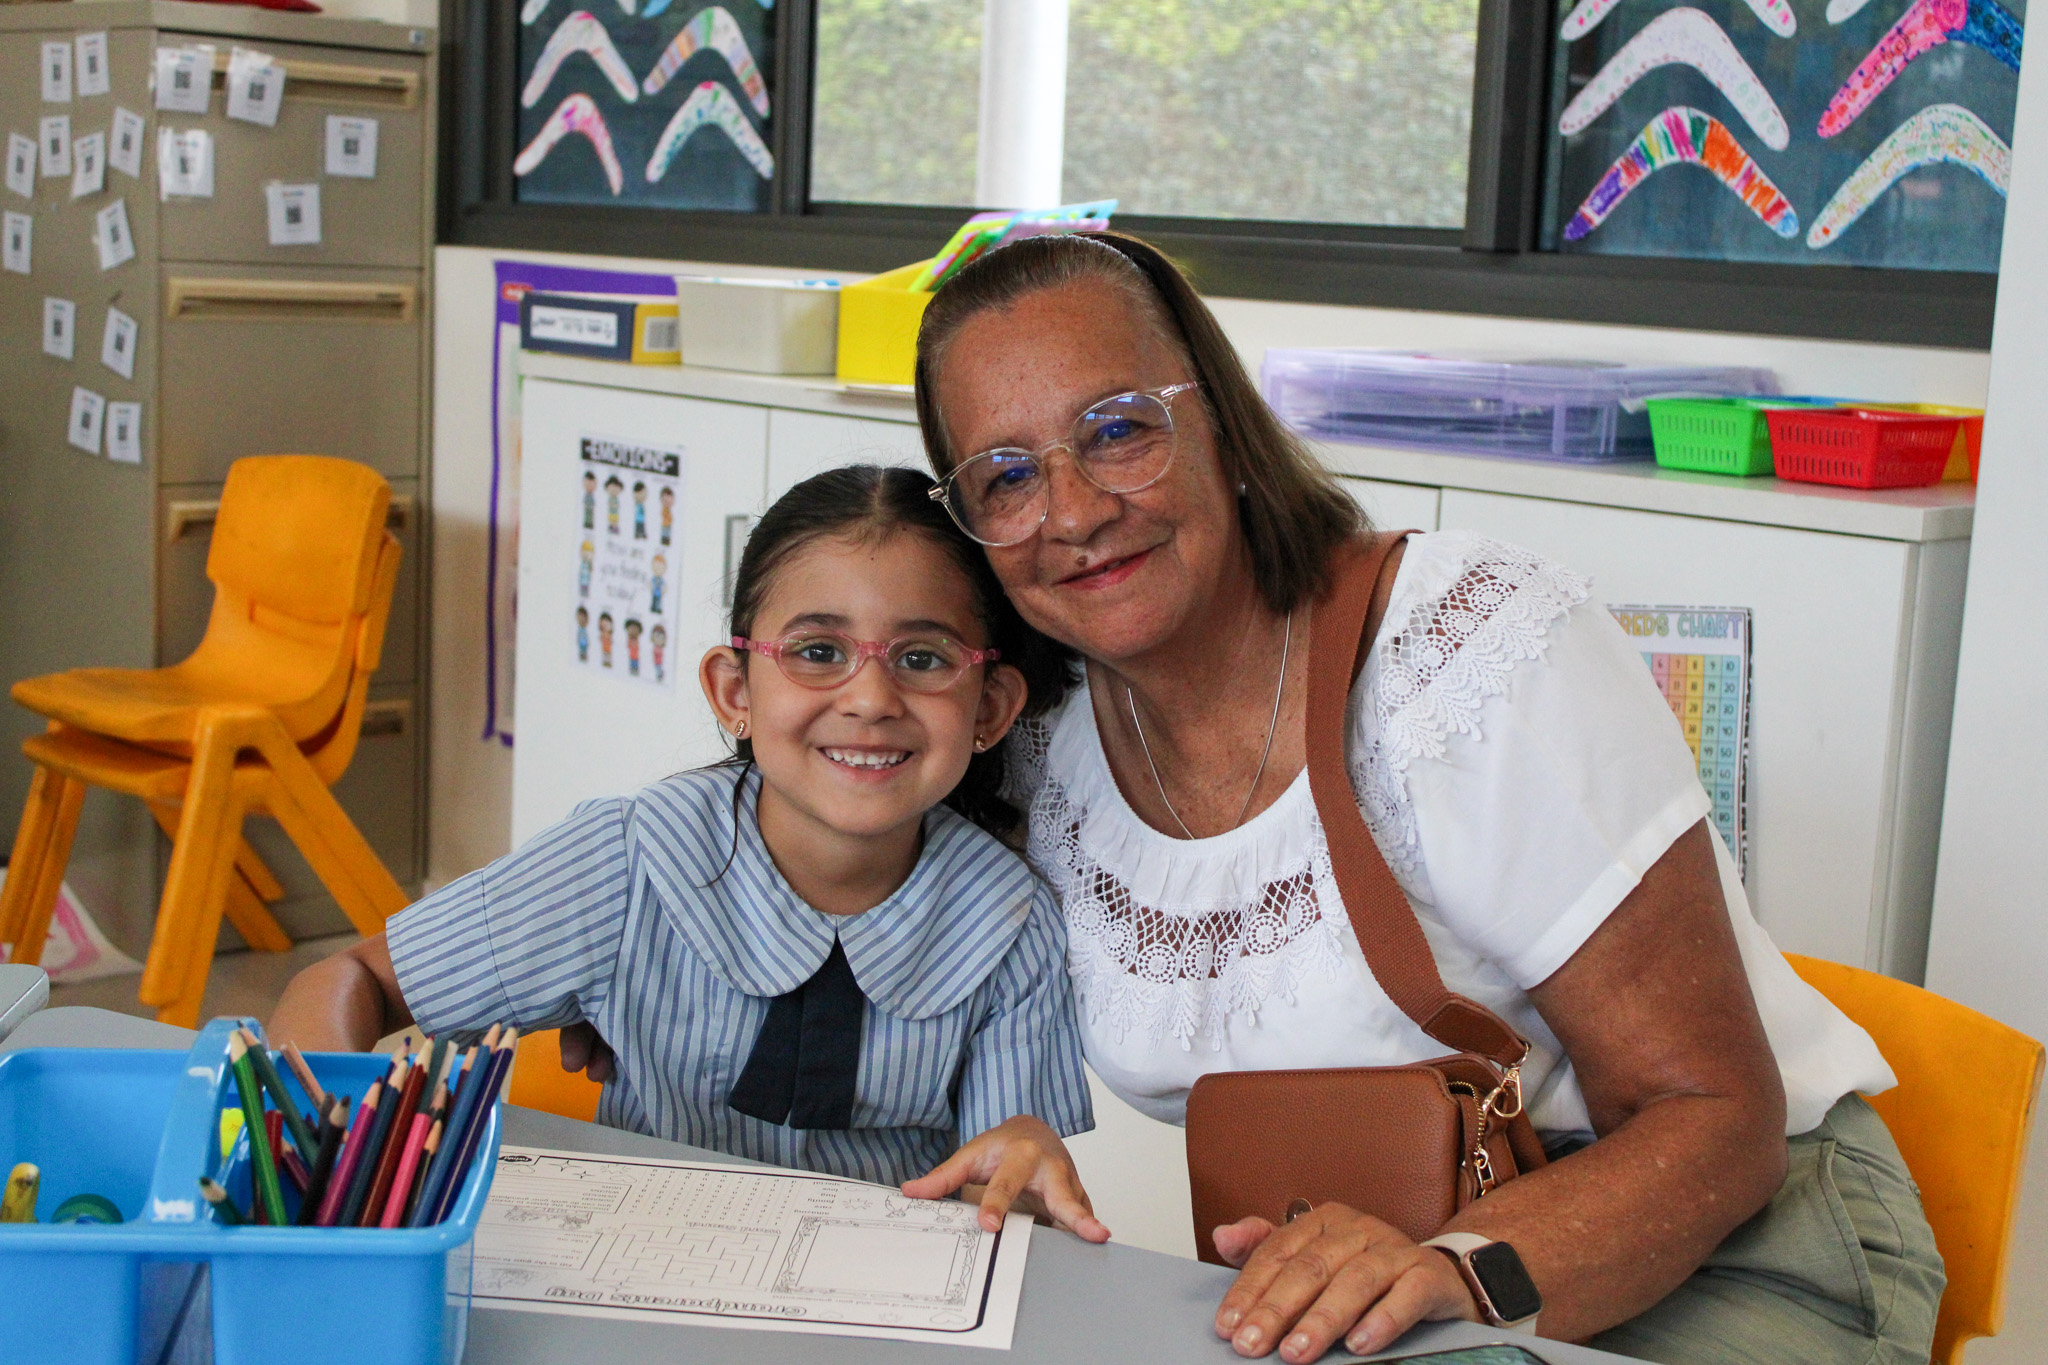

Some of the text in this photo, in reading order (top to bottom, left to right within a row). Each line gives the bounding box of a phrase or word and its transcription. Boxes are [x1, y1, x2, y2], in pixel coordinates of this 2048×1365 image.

[1611, 612, 1742, 639] REDS CHART
[1726, 661, 1735, 671] 10
[1724, 682, 1735, 693] 20
[1706, 703, 1716, 714] 29
[1723, 704, 1734, 715] 30
[1705, 725, 1715, 735] 39
[1722, 726, 1733, 736] 40
[1720, 747, 1732, 758] 50
[1702, 768, 1731, 780] 59 60
[1719, 790, 1730, 801] 70
[1719, 811, 1730, 822] 80
[565, 1204, 609, 1212] Unscramble
[793, 1208, 830, 1216] amazing
[545, 1286, 604, 1302] Day
